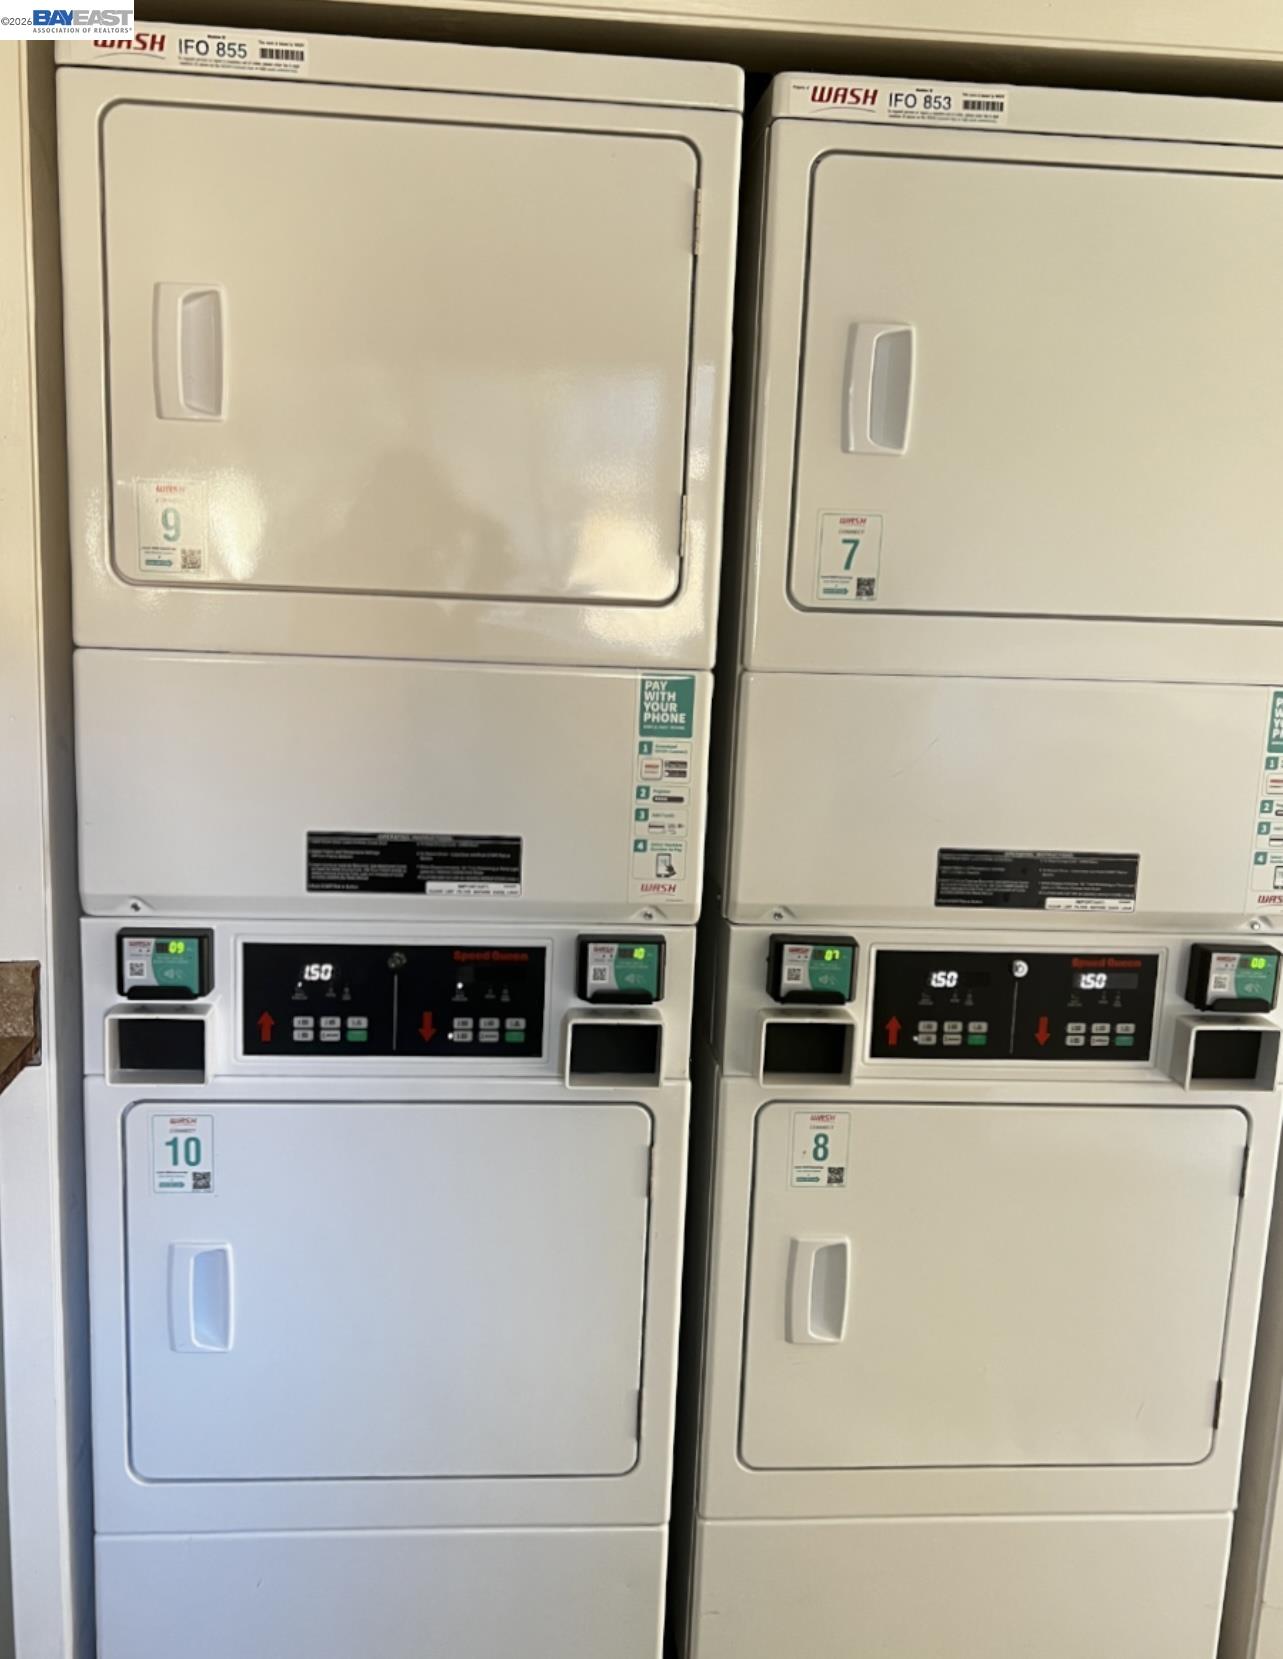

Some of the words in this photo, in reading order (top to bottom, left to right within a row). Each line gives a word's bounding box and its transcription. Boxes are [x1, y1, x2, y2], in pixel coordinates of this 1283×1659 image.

[178, 38, 209, 56] IFO
[216, 42, 247, 59] 855
[811, 85, 878, 105] WASH
[889, 92, 917, 109] IFO
[923, 94, 952, 110] 853
[162, 507, 181, 542] 9
[842, 539, 860, 571] 7
[645, 680, 668, 691] PAY
[644, 691, 677, 702] WITH
[643, 702, 678, 713] YOUR
[643, 712, 687, 724] PHONE
[643, 744, 648, 753] 1
[640, 788, 646, 798] 2
[1264, 803, 1270, 811] 2
[639, 810, 645, 820] 3
[1261, 825, 1267, 833] 3
[637, 841, 644, 851] 4
[1257, 854, 1264, 862] 4
[640, 883, 677, 893] WASH
[1257, 895, 1283, 904] WAS
[168, 941, 185, 954] 09
[824, 949, 840, 961] 07
[165, 1136, 201, 1167] 10
[813, 1132, 829, 1162] 8
